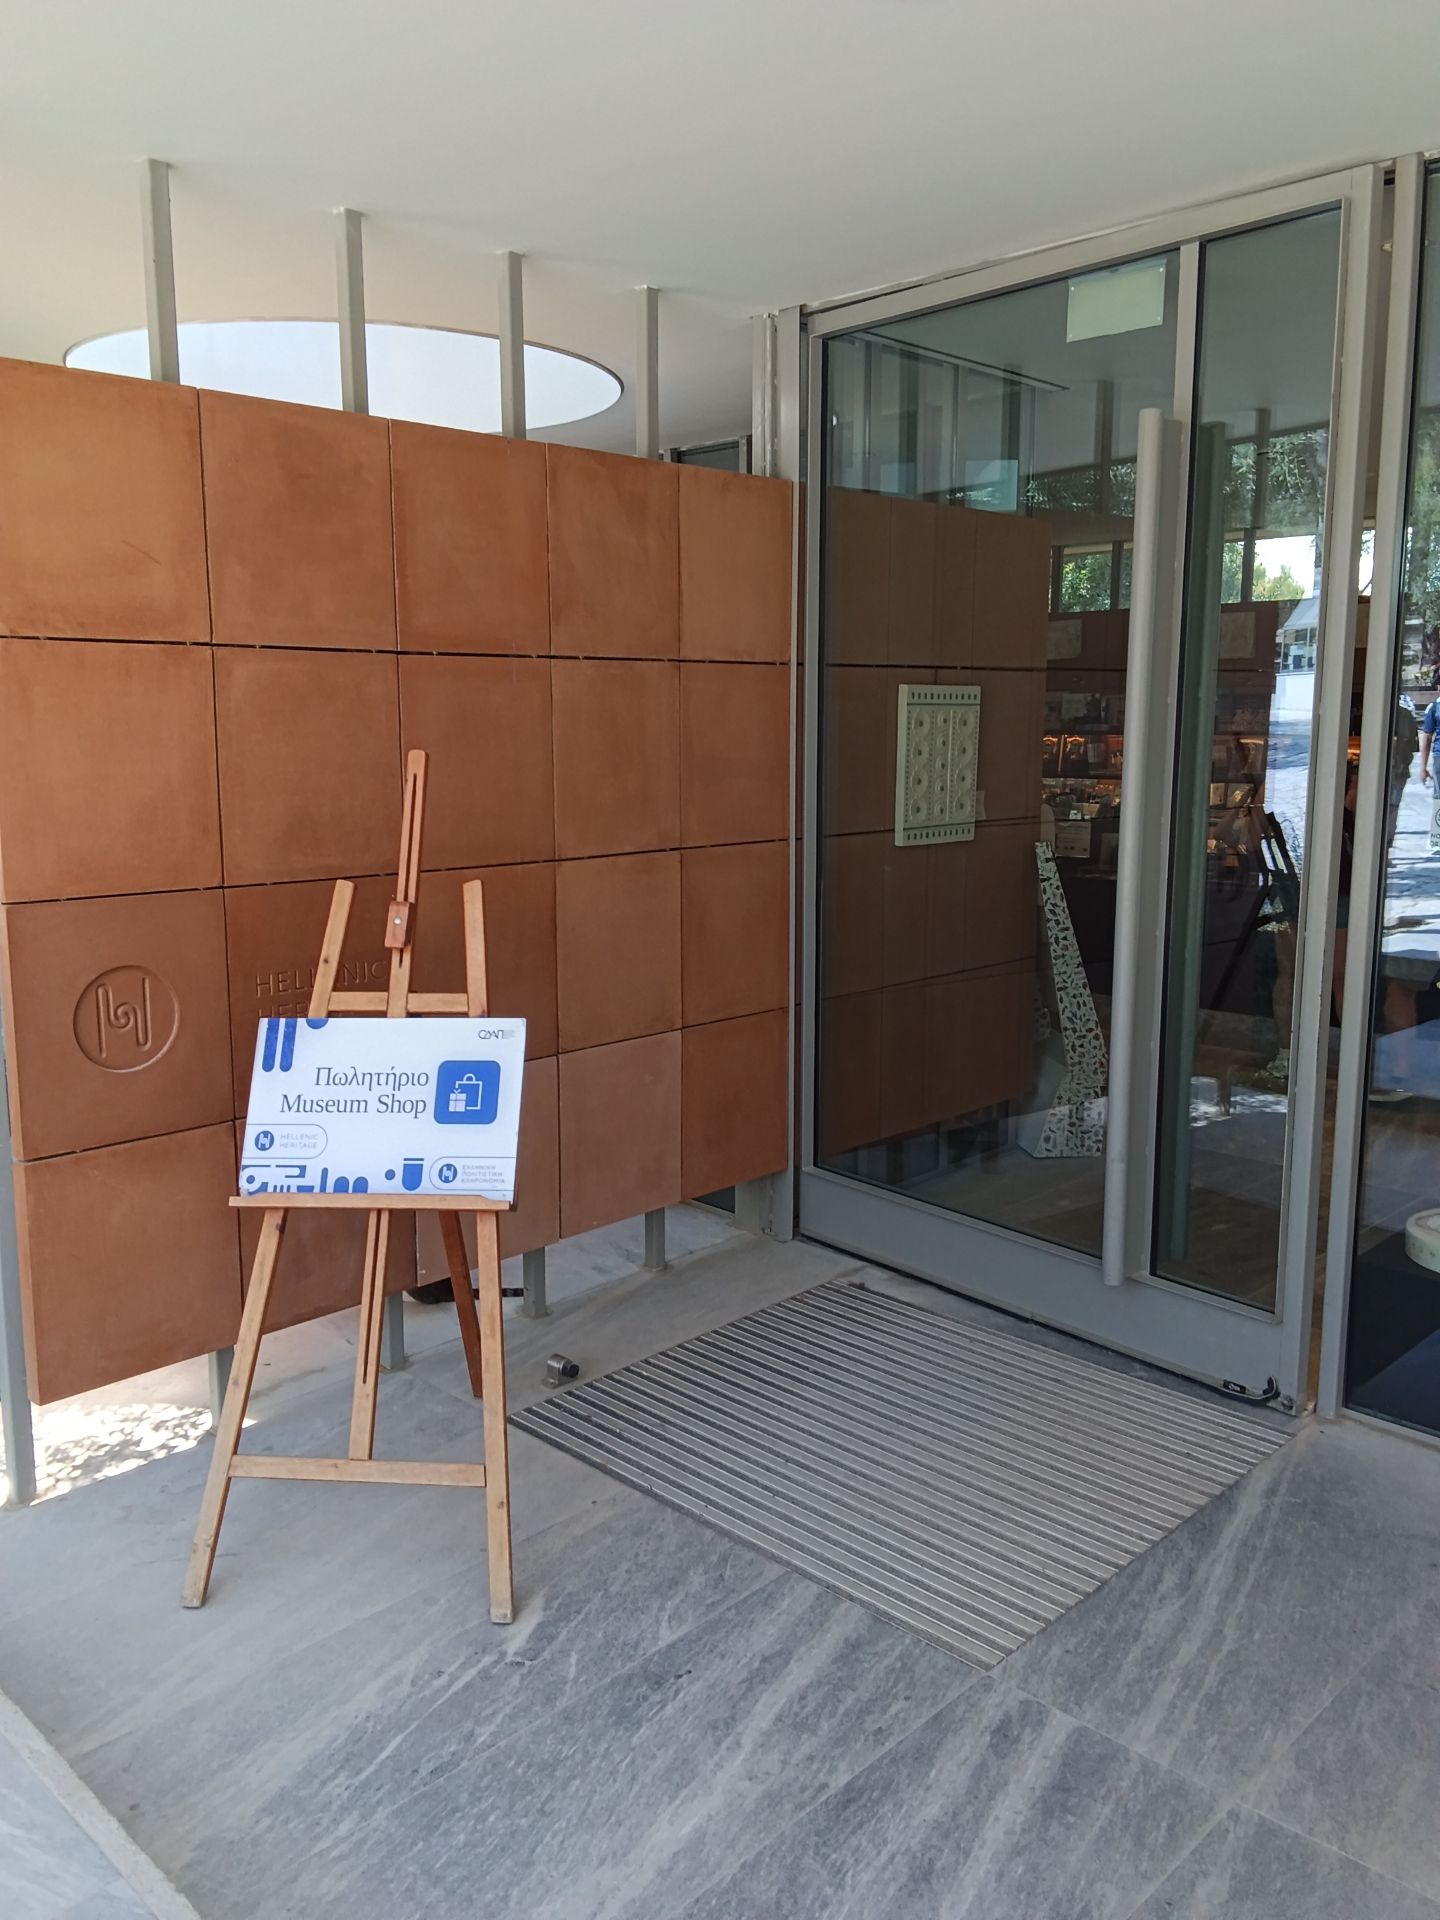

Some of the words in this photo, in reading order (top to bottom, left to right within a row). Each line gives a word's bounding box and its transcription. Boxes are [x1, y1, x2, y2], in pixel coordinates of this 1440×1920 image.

[256, 960, 387, 998] HELLNIC
[314, 1066, 430, 1091] Πωλητήριο
[280, 1093, 369, 1113] Museum
[376, 1093, 427, 1119] Shop
[279, 1141, 318, 1149] HERITAGE
